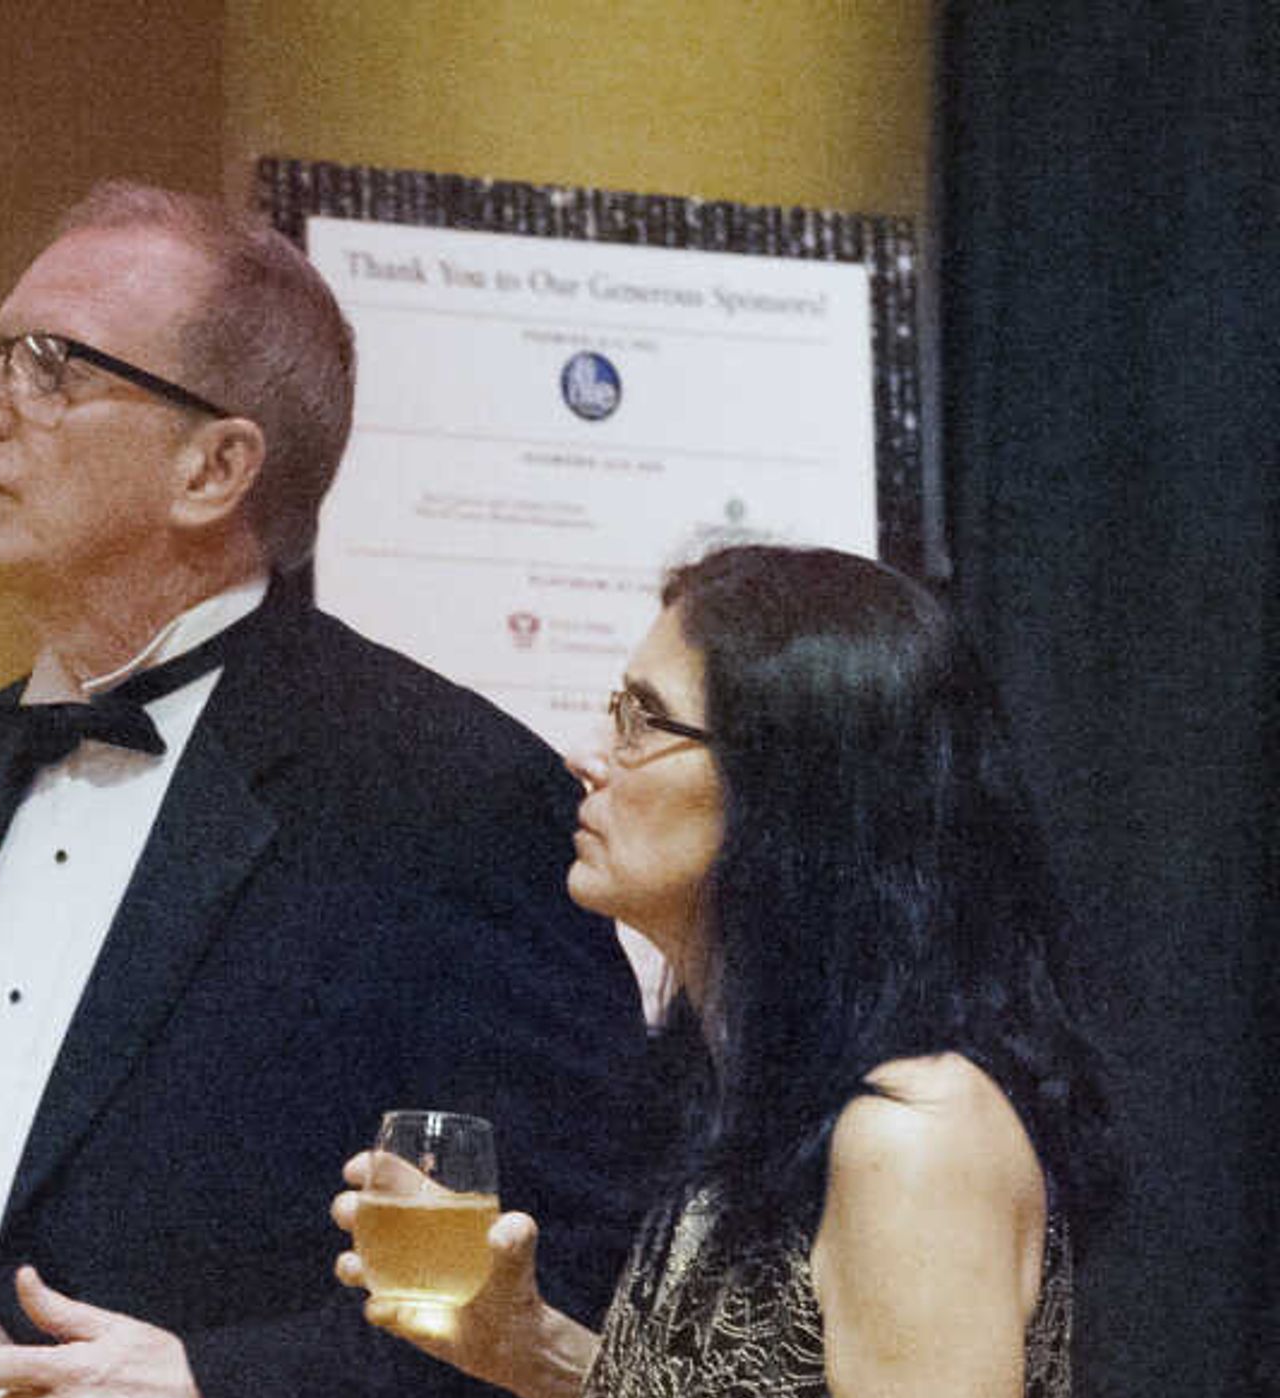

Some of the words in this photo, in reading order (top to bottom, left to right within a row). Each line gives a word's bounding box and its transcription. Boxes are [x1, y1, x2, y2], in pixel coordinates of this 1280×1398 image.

[341, 248, 428, 286] Thank
[435, 257, 486, 291] You
[494, 265, 523, 292] to
[526, 266, 578, 296] Our
[586, 268, 704, 311] Generous
